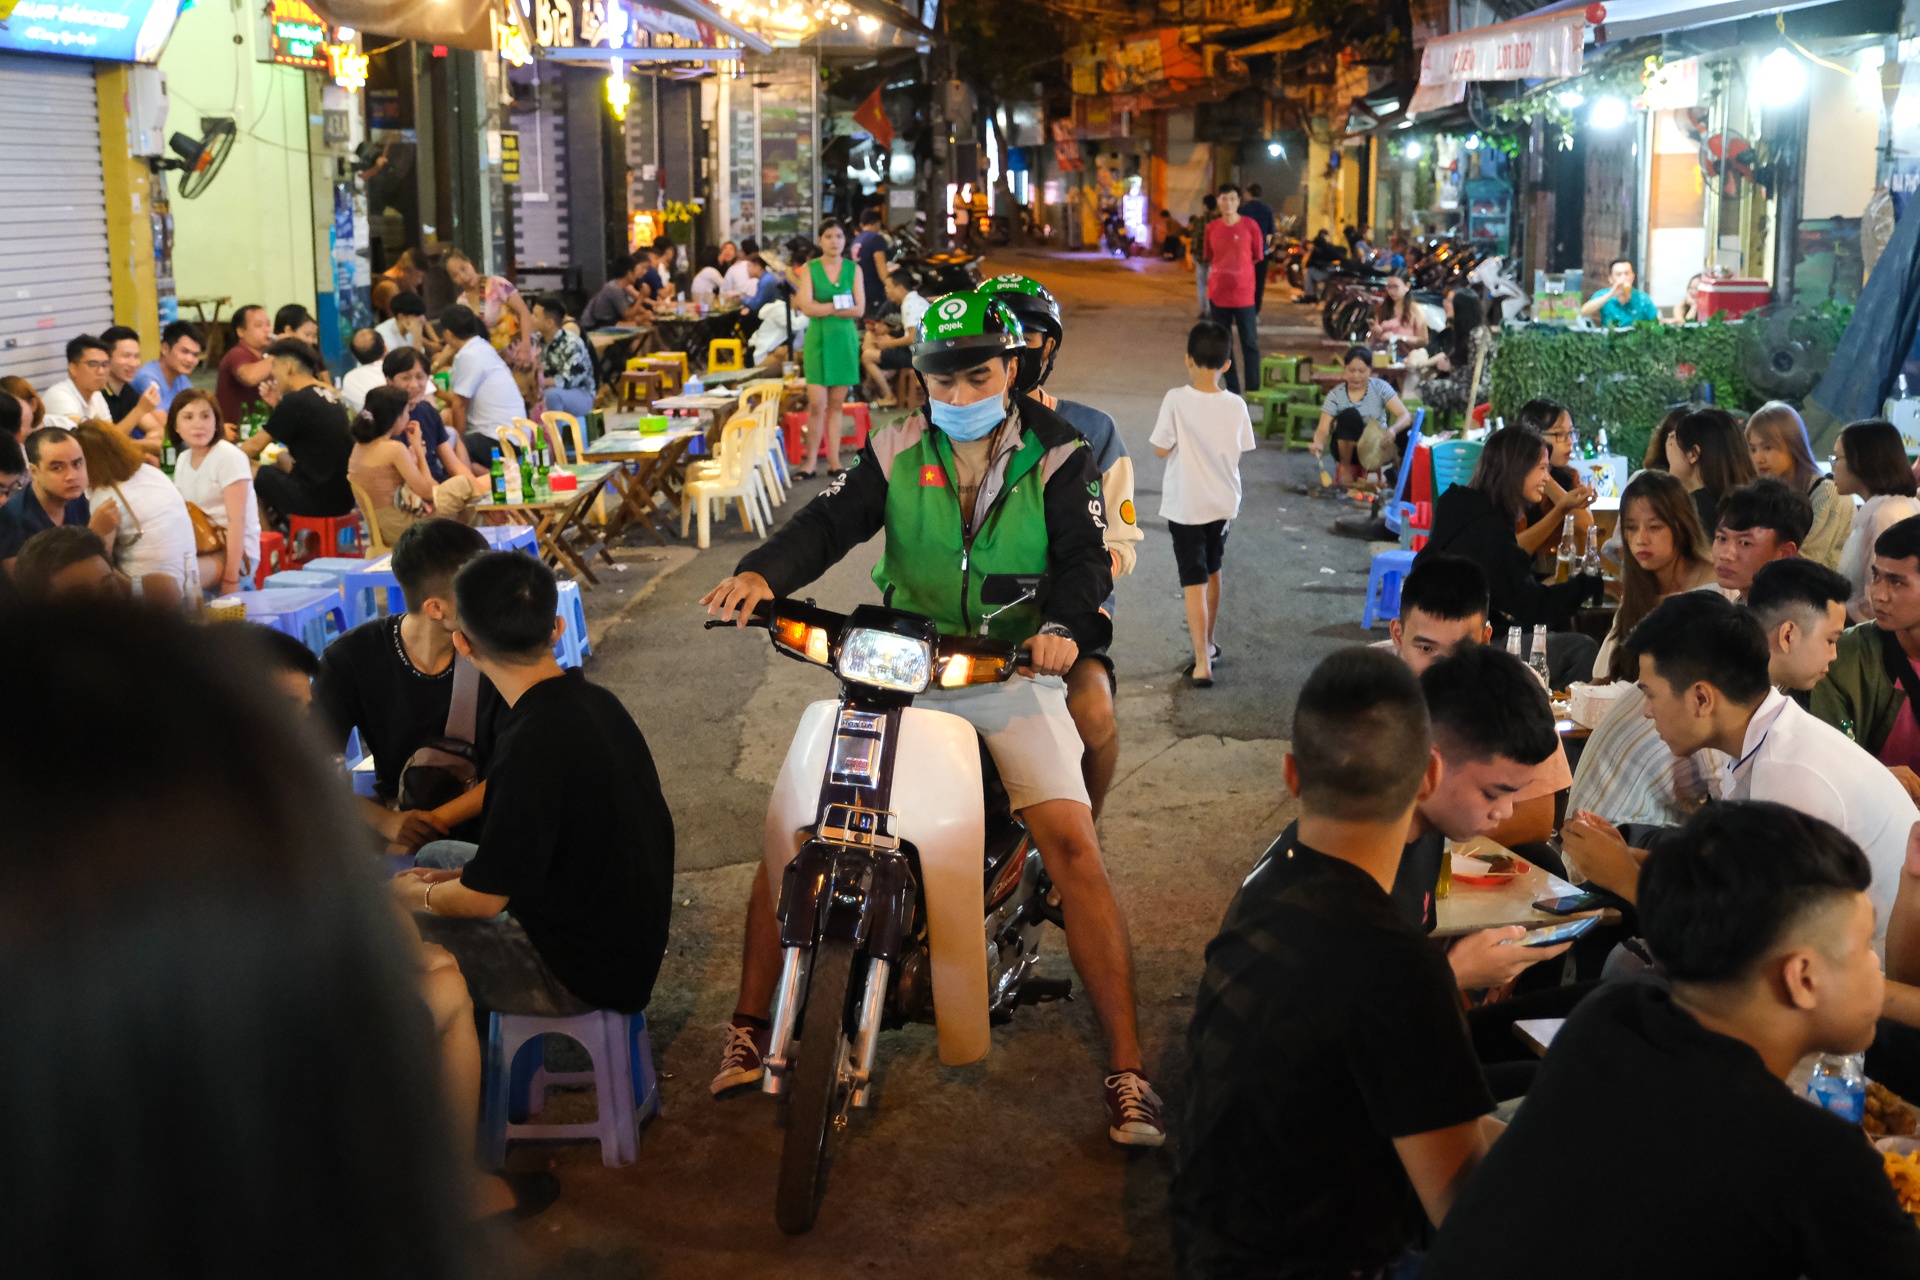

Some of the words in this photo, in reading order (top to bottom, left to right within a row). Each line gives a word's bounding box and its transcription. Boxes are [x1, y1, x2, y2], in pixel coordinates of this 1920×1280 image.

[997, 282, 1019, 290] gojek
[938, 321, 963, 333] gojek
[841, 718, 874, 730] HONDA
